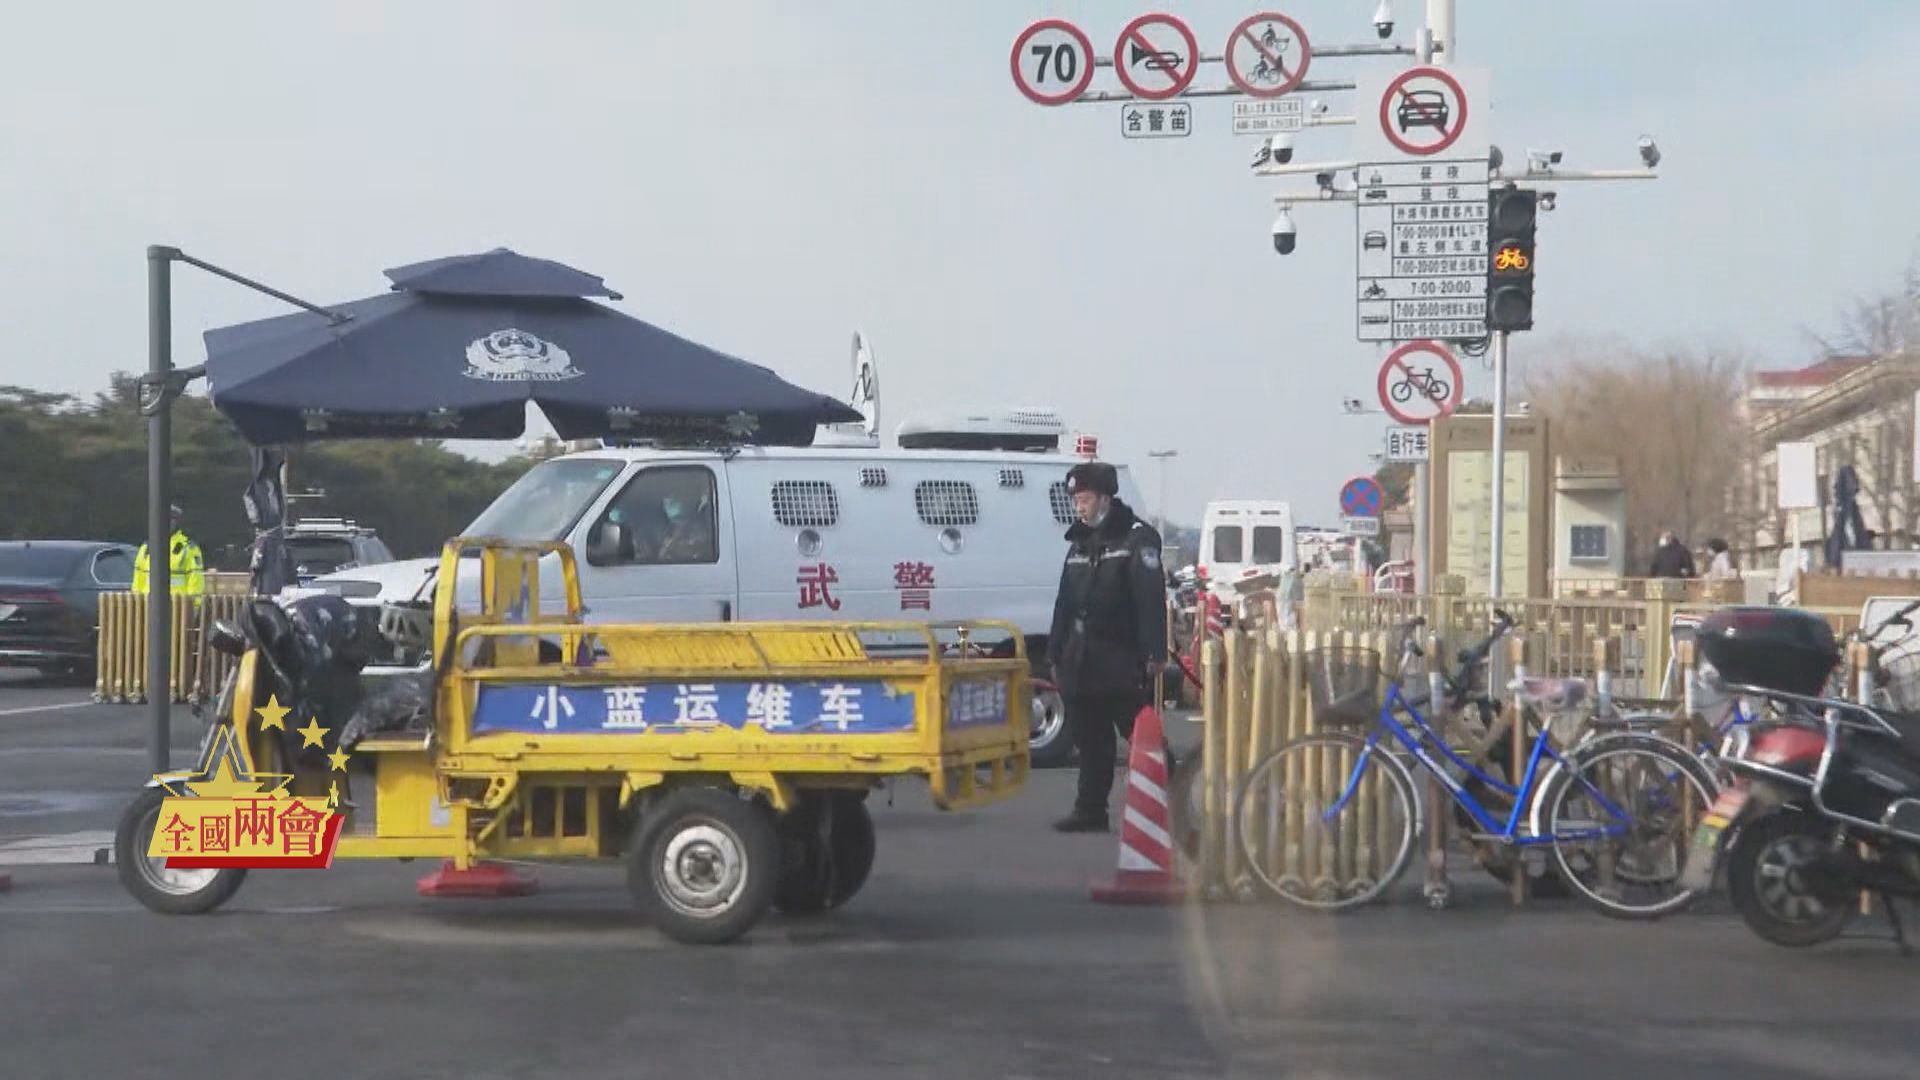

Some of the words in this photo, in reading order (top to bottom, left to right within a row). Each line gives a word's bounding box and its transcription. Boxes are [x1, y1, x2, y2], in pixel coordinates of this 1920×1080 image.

[1031, 44, 1076, 83] 70
[1126, 110, 1187, 132] 含警笛
[1411, 280, 1471, 295] 7:00-20:00
[1390, 432, 1427, 454] 自行车
[797, 562, 936, 611] 武警
[531, 683, 865, 730] 小蓝运维车
